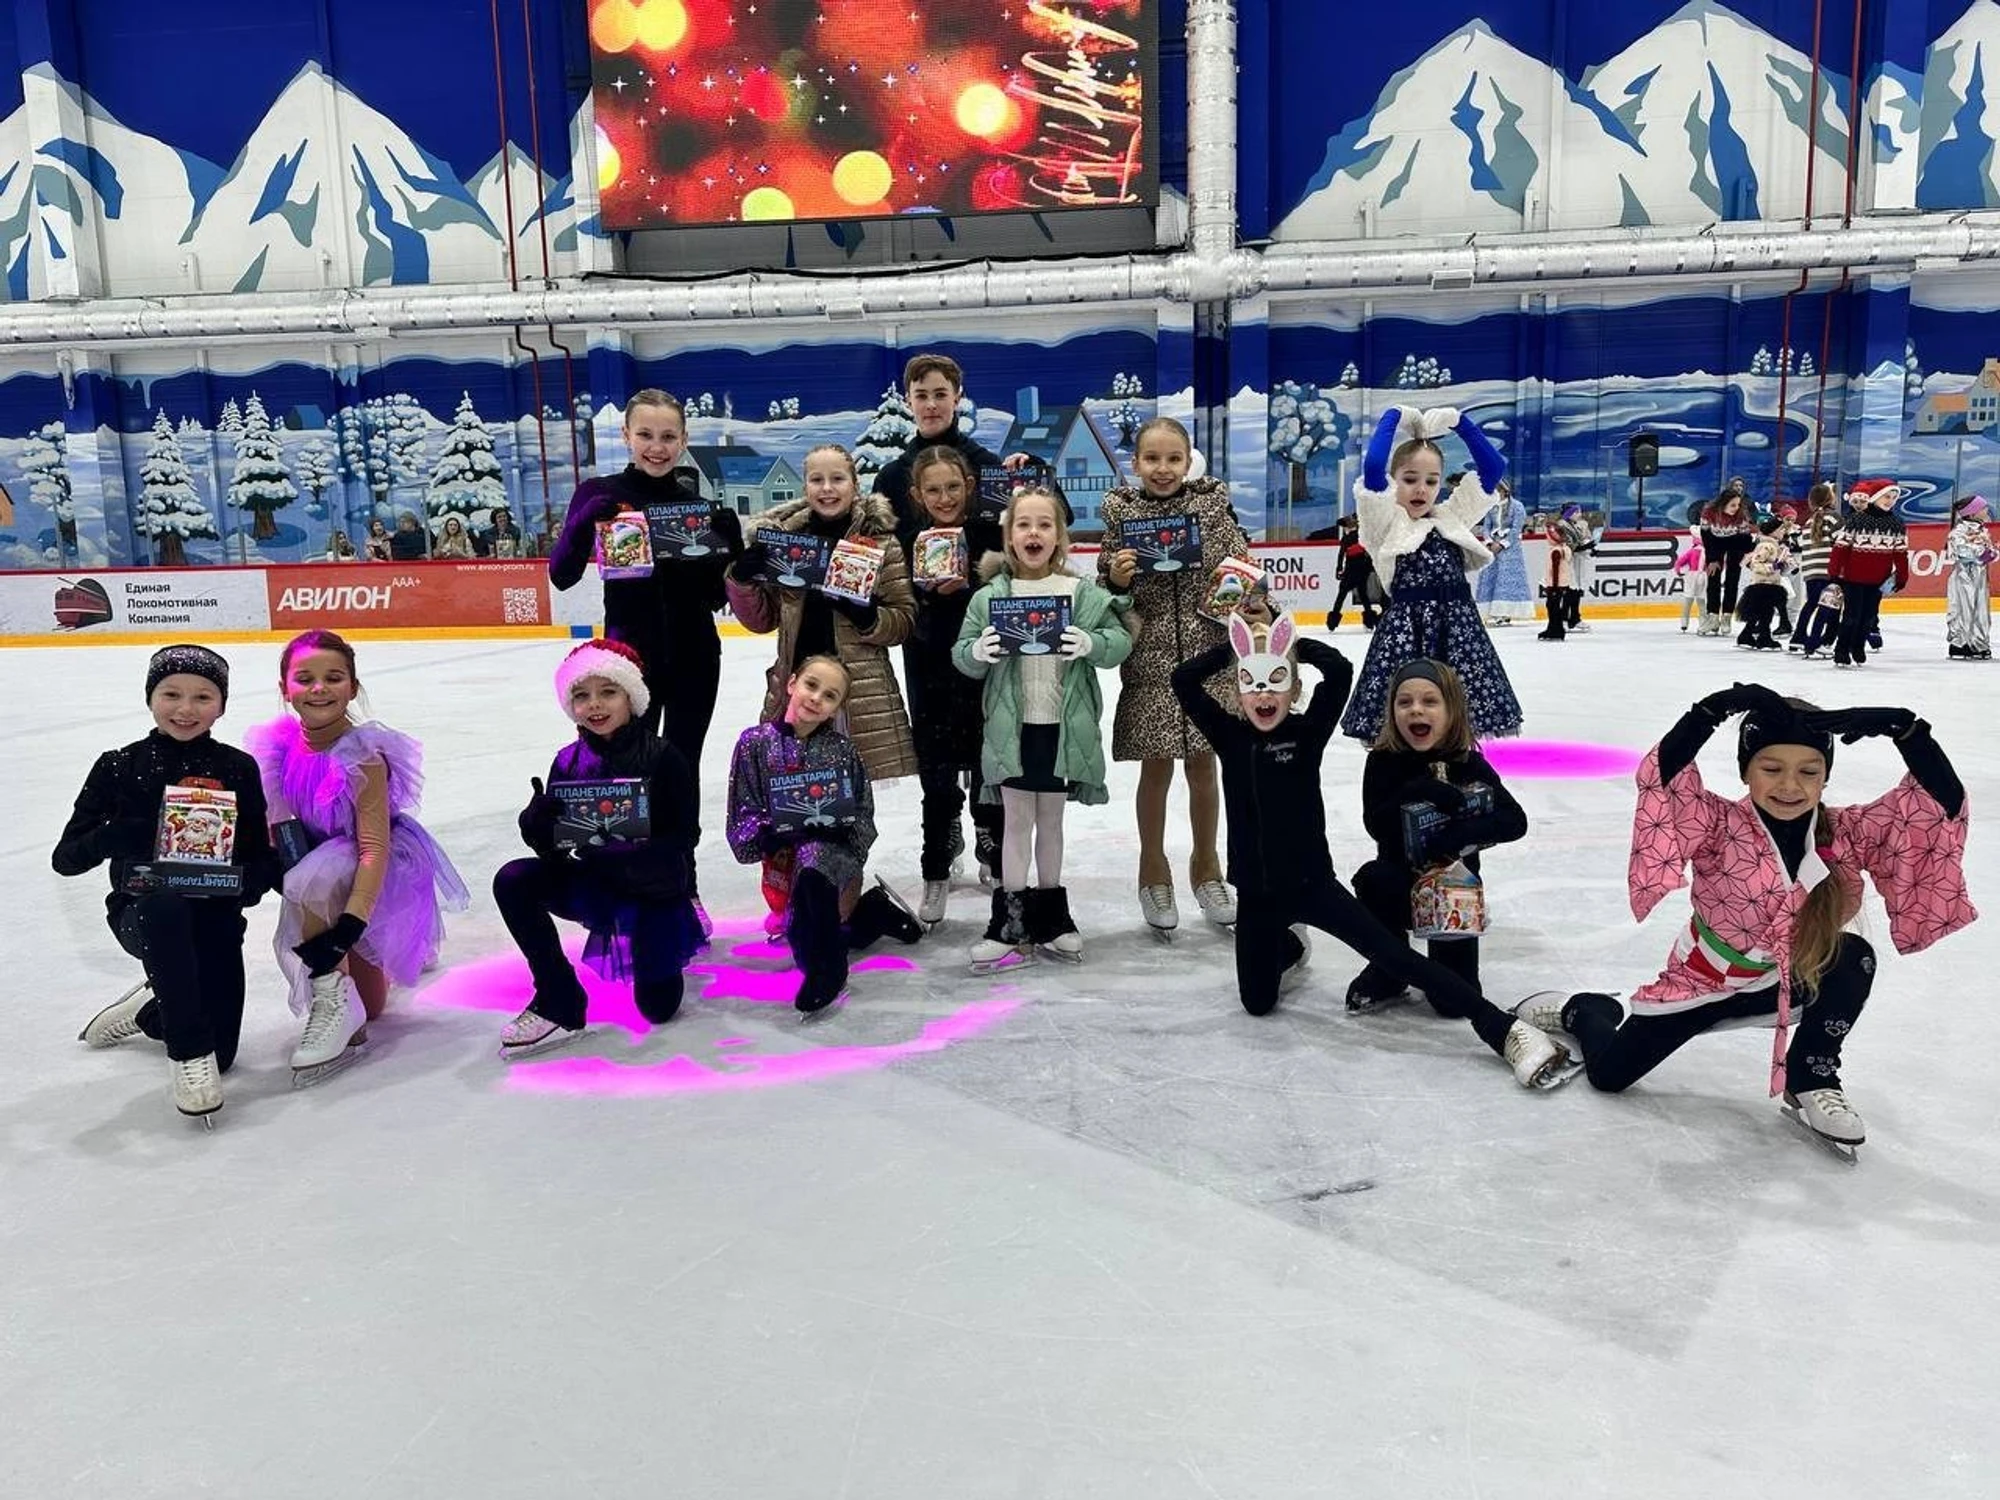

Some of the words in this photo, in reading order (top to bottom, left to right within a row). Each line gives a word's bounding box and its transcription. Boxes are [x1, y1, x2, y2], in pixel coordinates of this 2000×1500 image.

[648, 501, 711, 516] ПЛАНЕТАРИЙ
[1123, 515, 1186, 532] ПЛАНЕТАРИЙ
[757, 529, 818, 547] ПЛАНЕТАРИЙ
[125, 583, 171, 594] Единая
[127, 598, 218, 609] Локомотивная
[276, 586, 391, 611] АВИЛОН
[991, 597, 1056, 610] ПЛАНЕТАРИЙ
[128, 613, 191, 624] Компания
[770, 768, 837, 787] ПЛАНЕТАРИЙ
[554, 783, 632, 798] ПЛАНЕТАРИЙ
